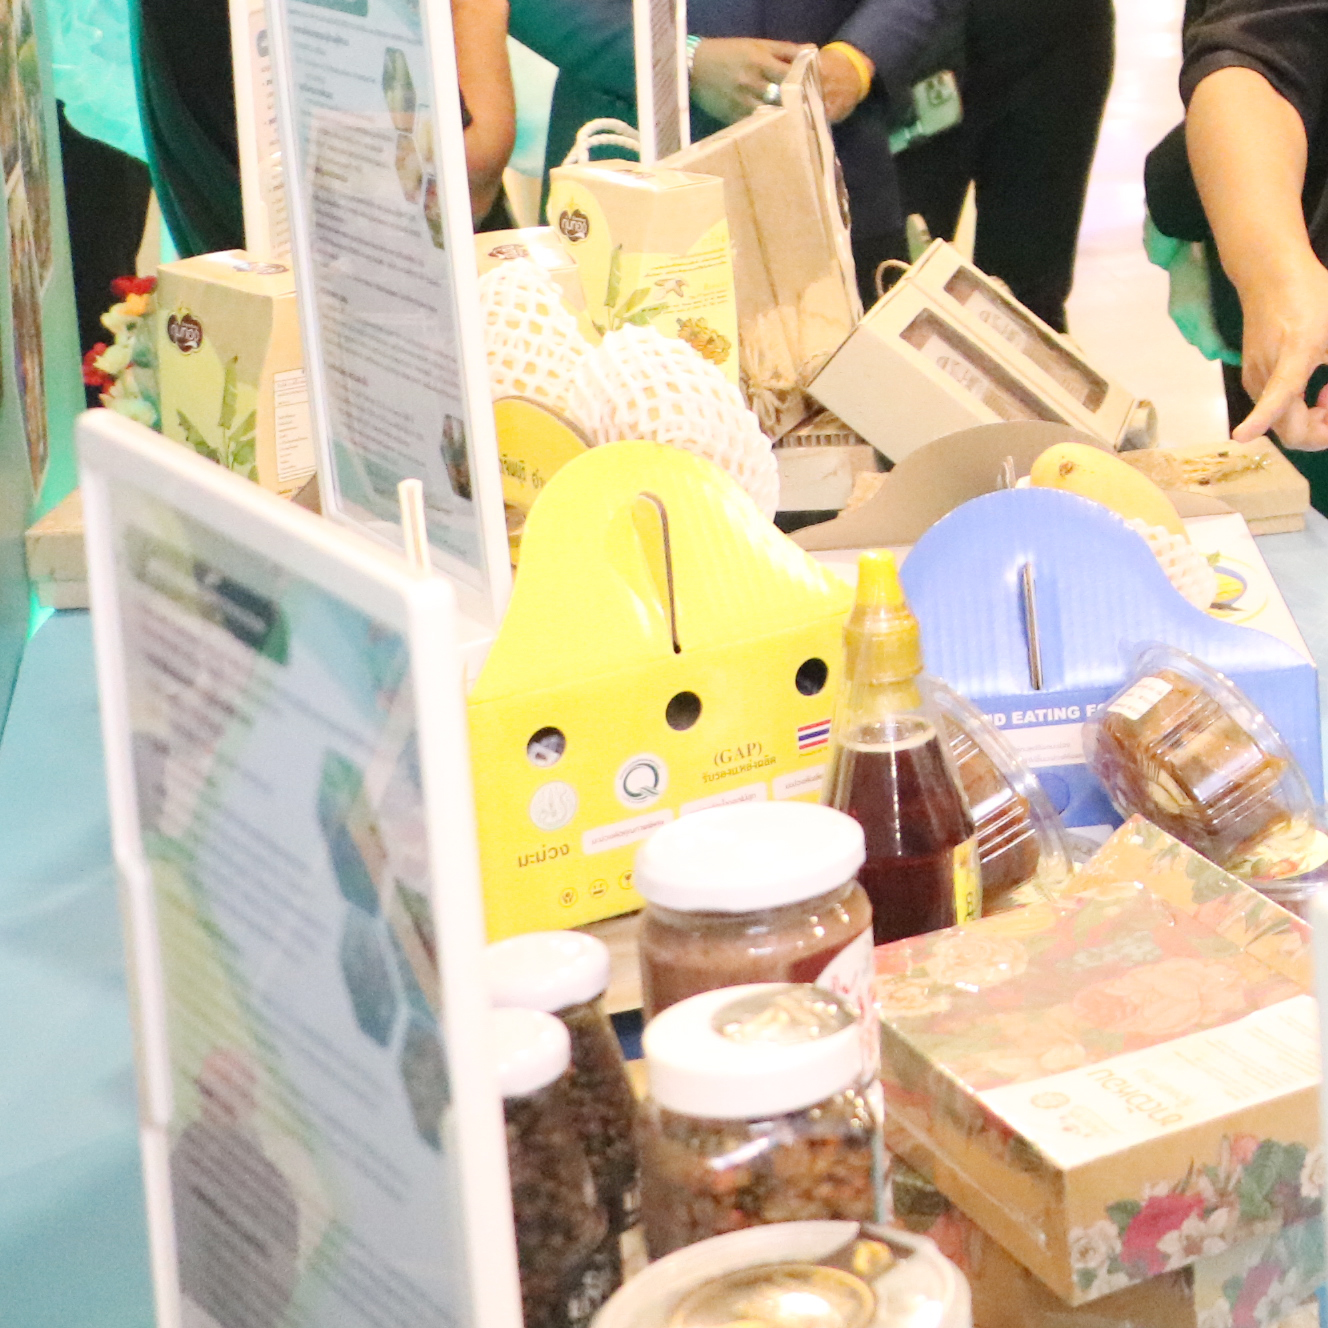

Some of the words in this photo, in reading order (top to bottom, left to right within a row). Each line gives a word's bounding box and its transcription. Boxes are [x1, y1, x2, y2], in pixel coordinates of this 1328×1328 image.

[1012, 705, 1080, 725] EATING
[713, 741, 763, 767] (GAP)
[517, 843, 570, 868] มะม่วง
